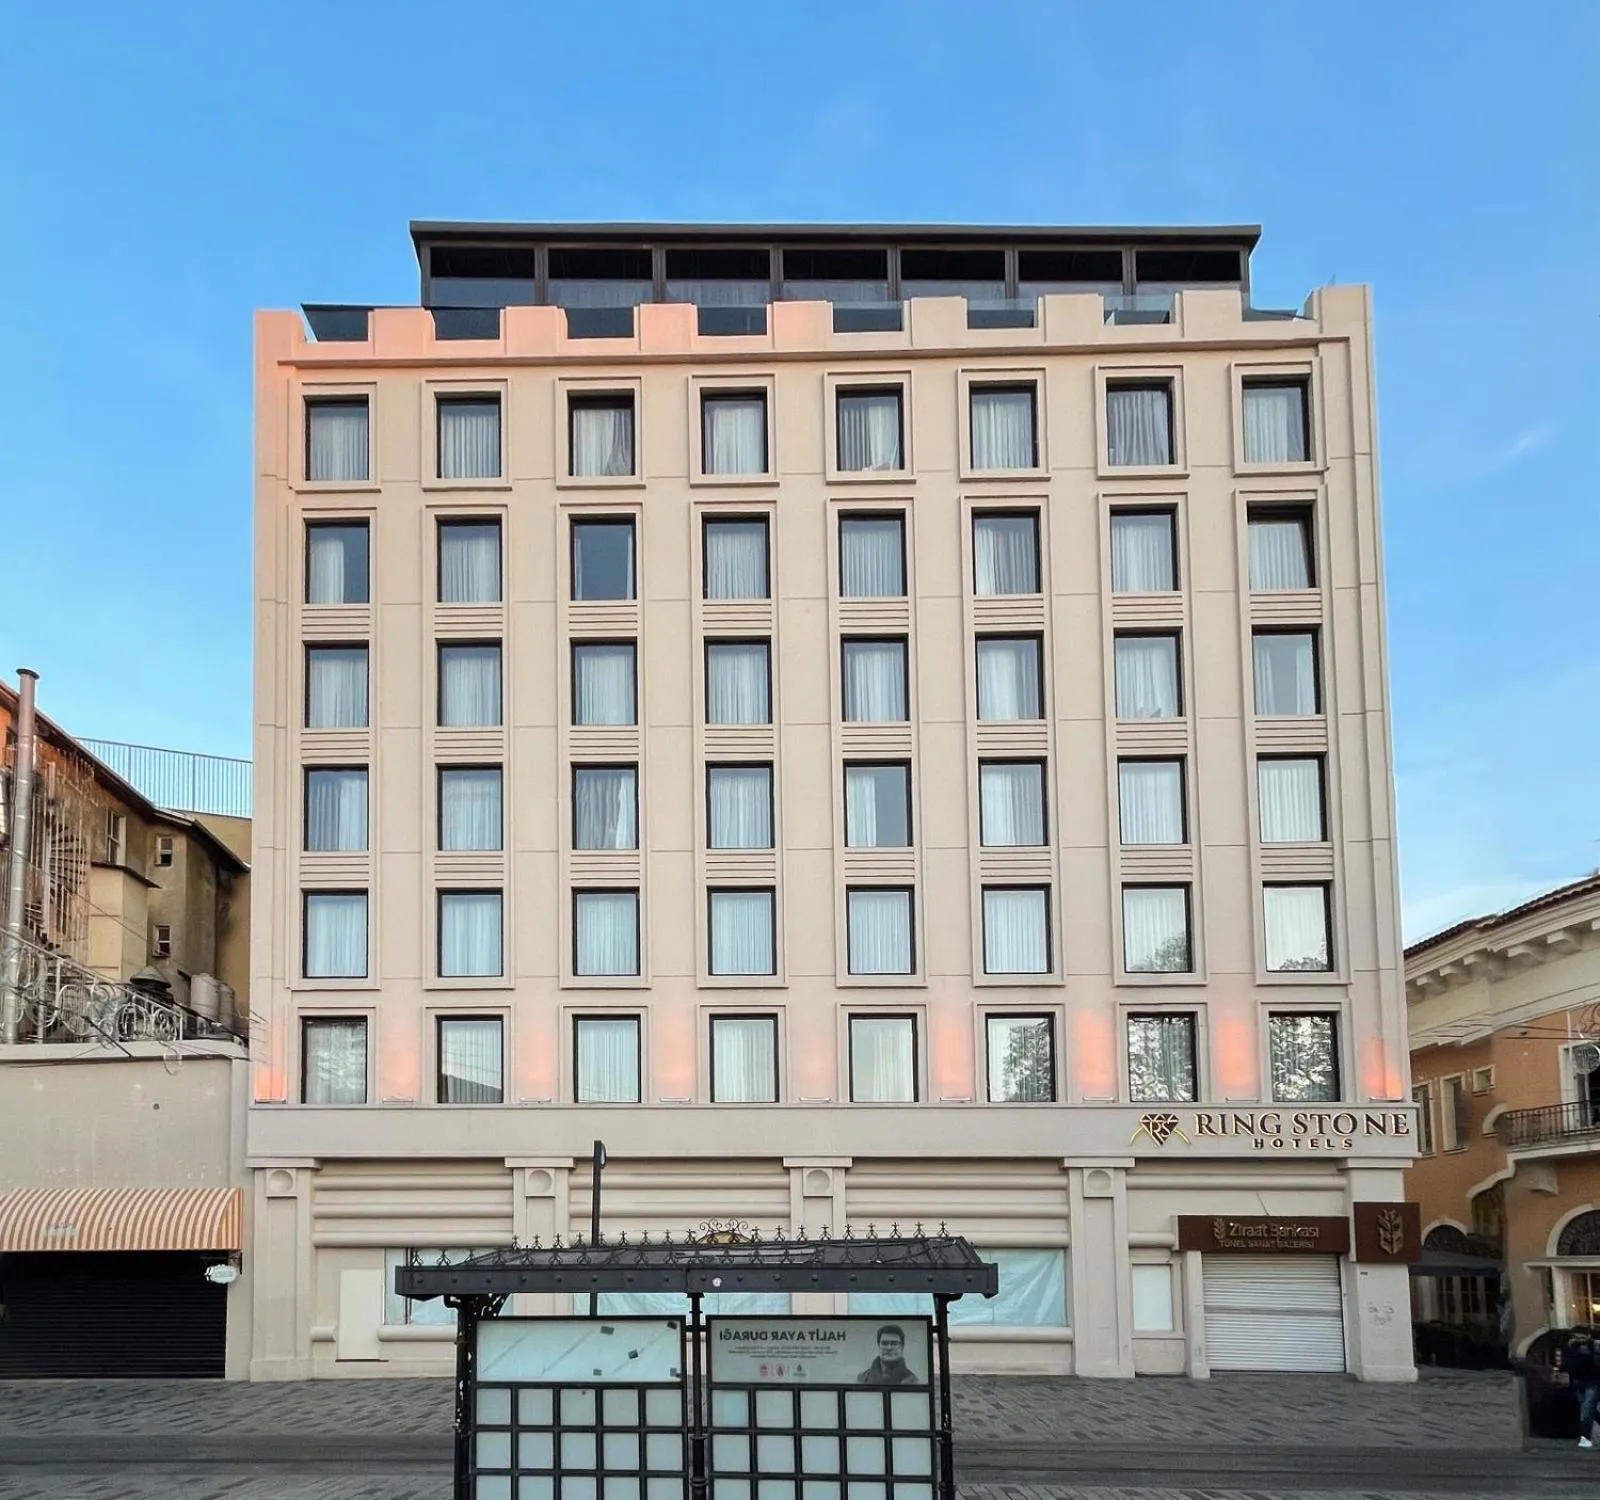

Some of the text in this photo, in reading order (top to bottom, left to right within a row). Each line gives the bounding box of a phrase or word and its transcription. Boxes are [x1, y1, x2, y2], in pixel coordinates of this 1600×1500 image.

[1194, 1113, 1410, 1137] RING STONE
[1252, 1138, 1353, 1150] HOTELS
[1229, 1222, 1268, 1238] Ziraat
